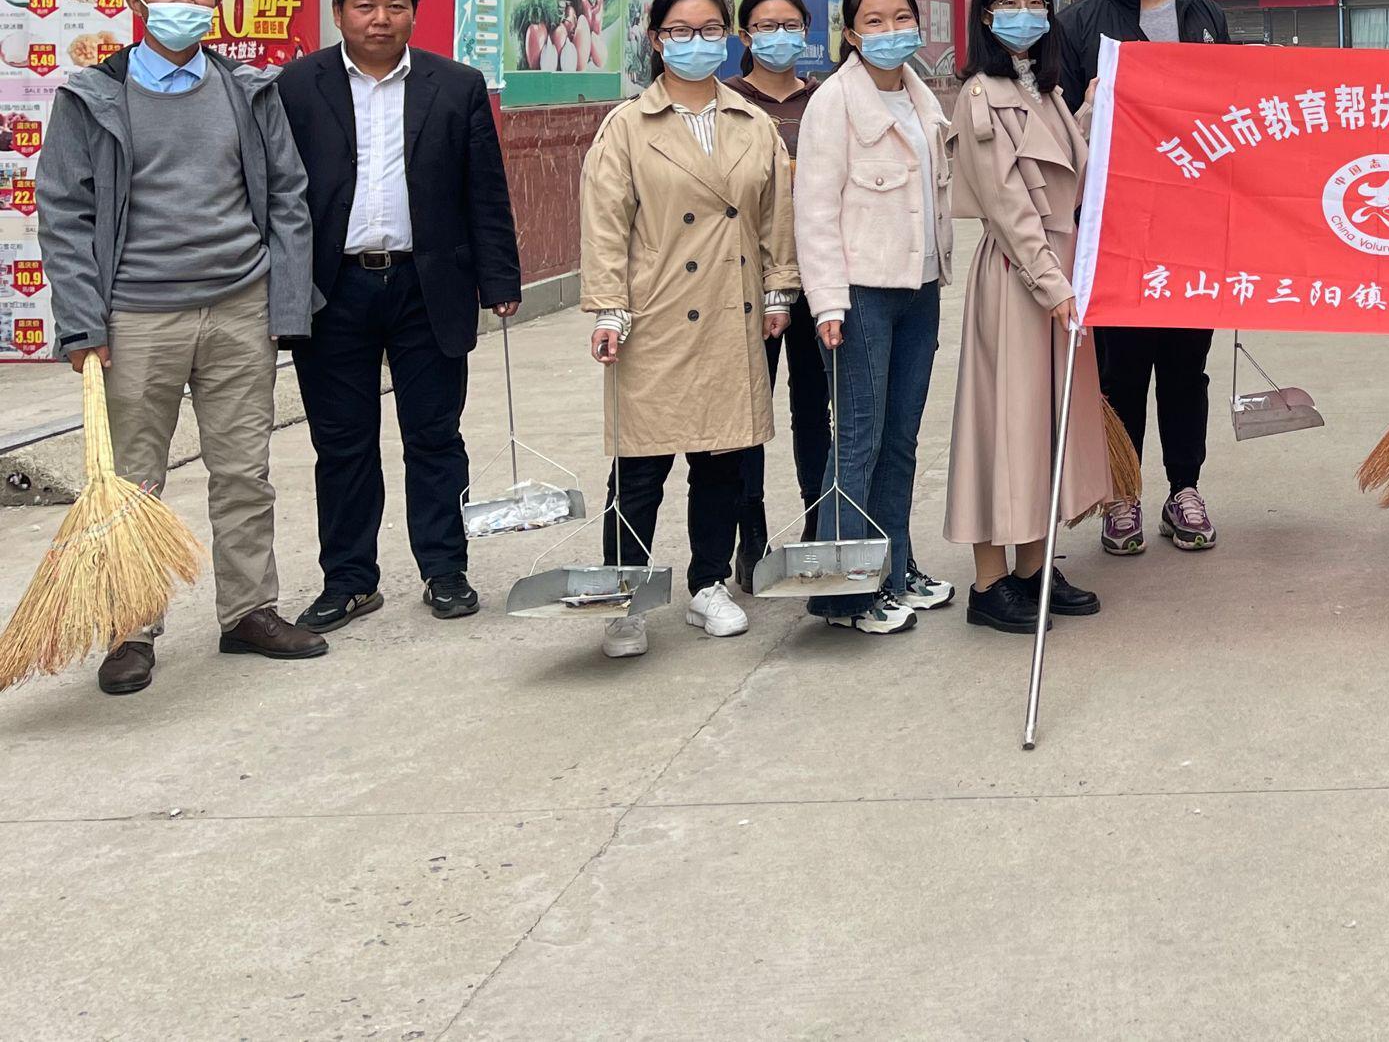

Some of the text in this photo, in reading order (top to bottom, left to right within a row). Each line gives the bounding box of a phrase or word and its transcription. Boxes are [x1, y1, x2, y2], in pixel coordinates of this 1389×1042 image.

[31, 54, 55, 66] 5.49
[16, 133, 39, 145] 12.8
[1331, 215, 1356, 241] China
[16, 272, 40, 285] 10.9
[16, 331, 42, 343] 3.90
